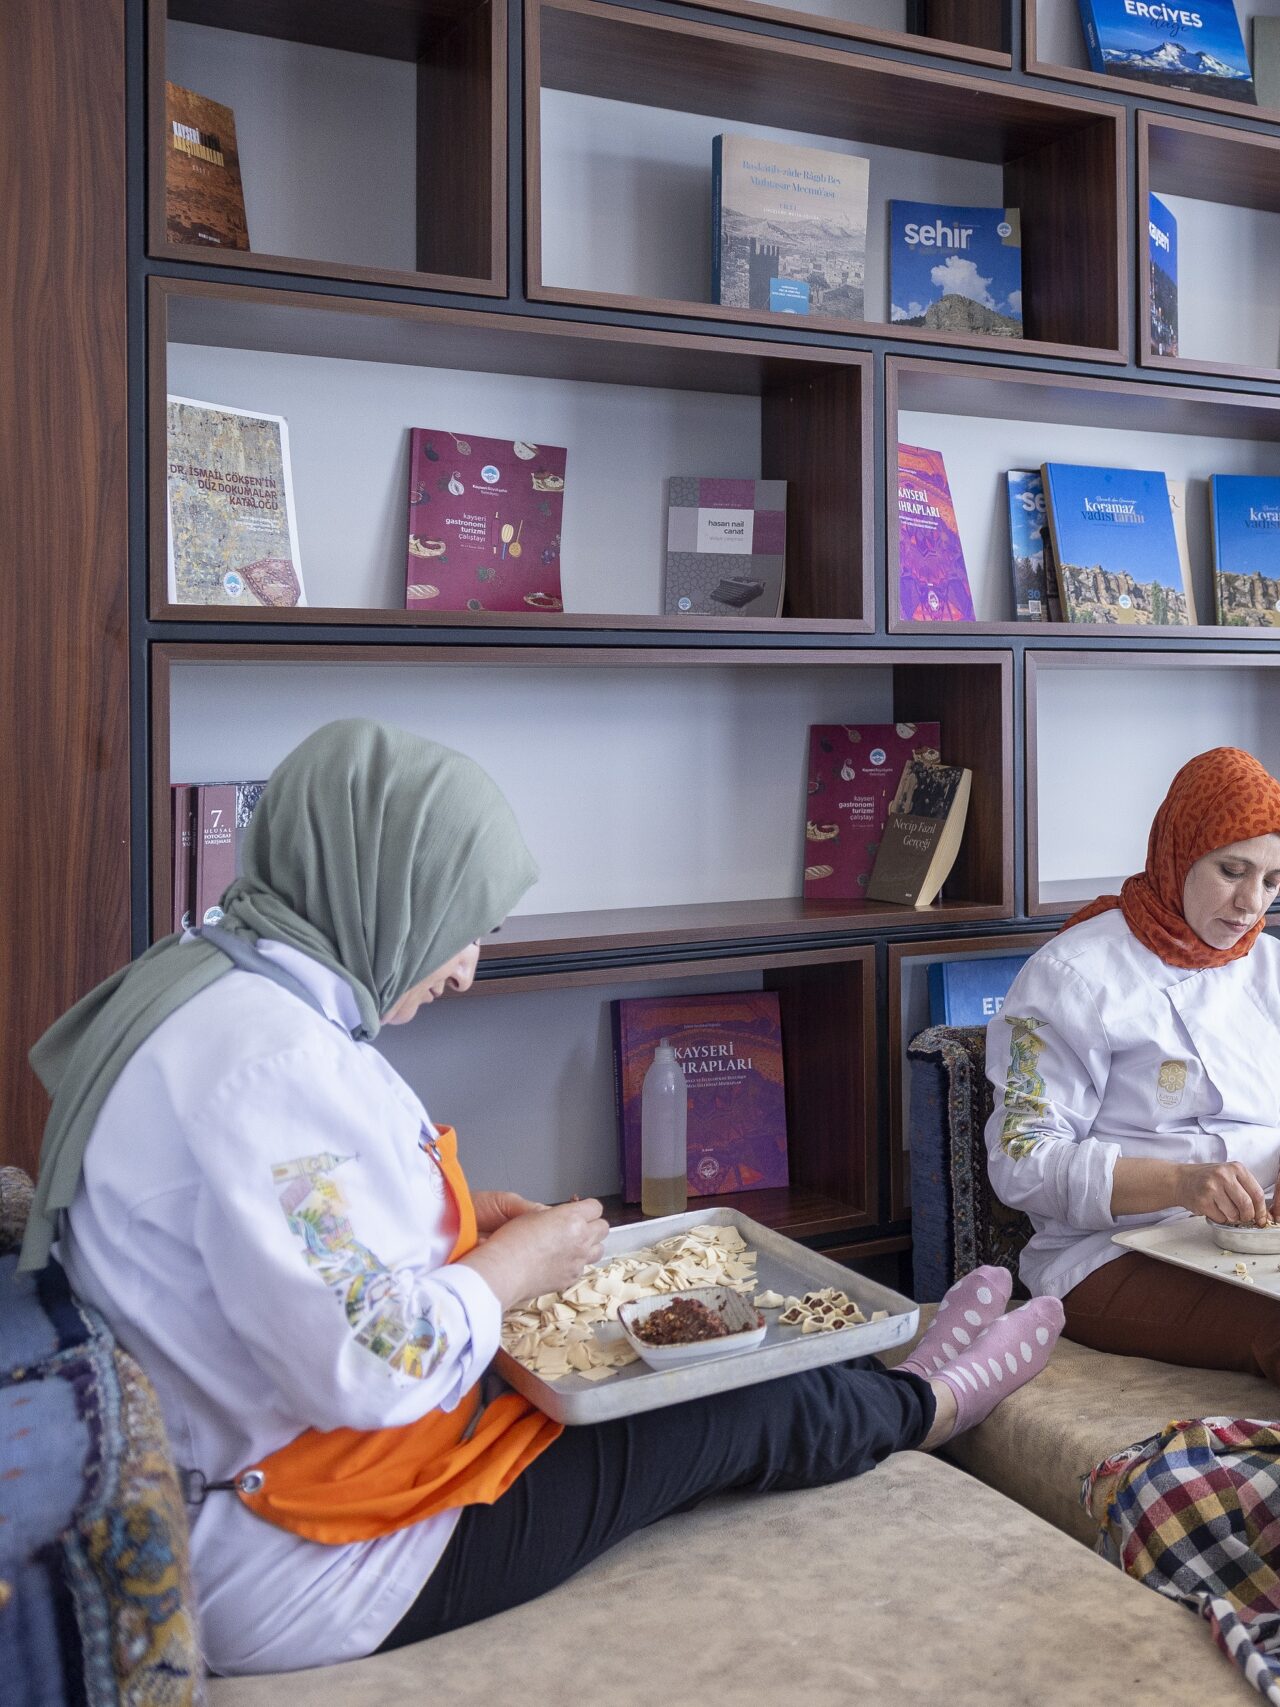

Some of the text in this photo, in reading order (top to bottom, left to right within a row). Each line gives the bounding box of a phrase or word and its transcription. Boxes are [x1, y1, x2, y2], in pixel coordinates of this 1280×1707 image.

[1124, 0, 1203, 28] ERCİYES
[169, 464, 187, 475] DR.
[189, 464, 223, 481] İSMAİL
[198, 479, 278, 500] DÜZ DOKUMALAR
[1084, 497, 1135, 514] koramaz
[445, 518, 486, 529] gastronomi
[463, 512, 487, 522] kayseri
[708, 519, 745, 528] hasan nail
[461, 526, 486, 535] turizmi
[838, 801, 875, 809] gastronomi
[893, 817, 918, 835] Necip
[903, 835, 932, 852] Gerçeği
[674, 1041, 734, 1060] KAYSERİ
